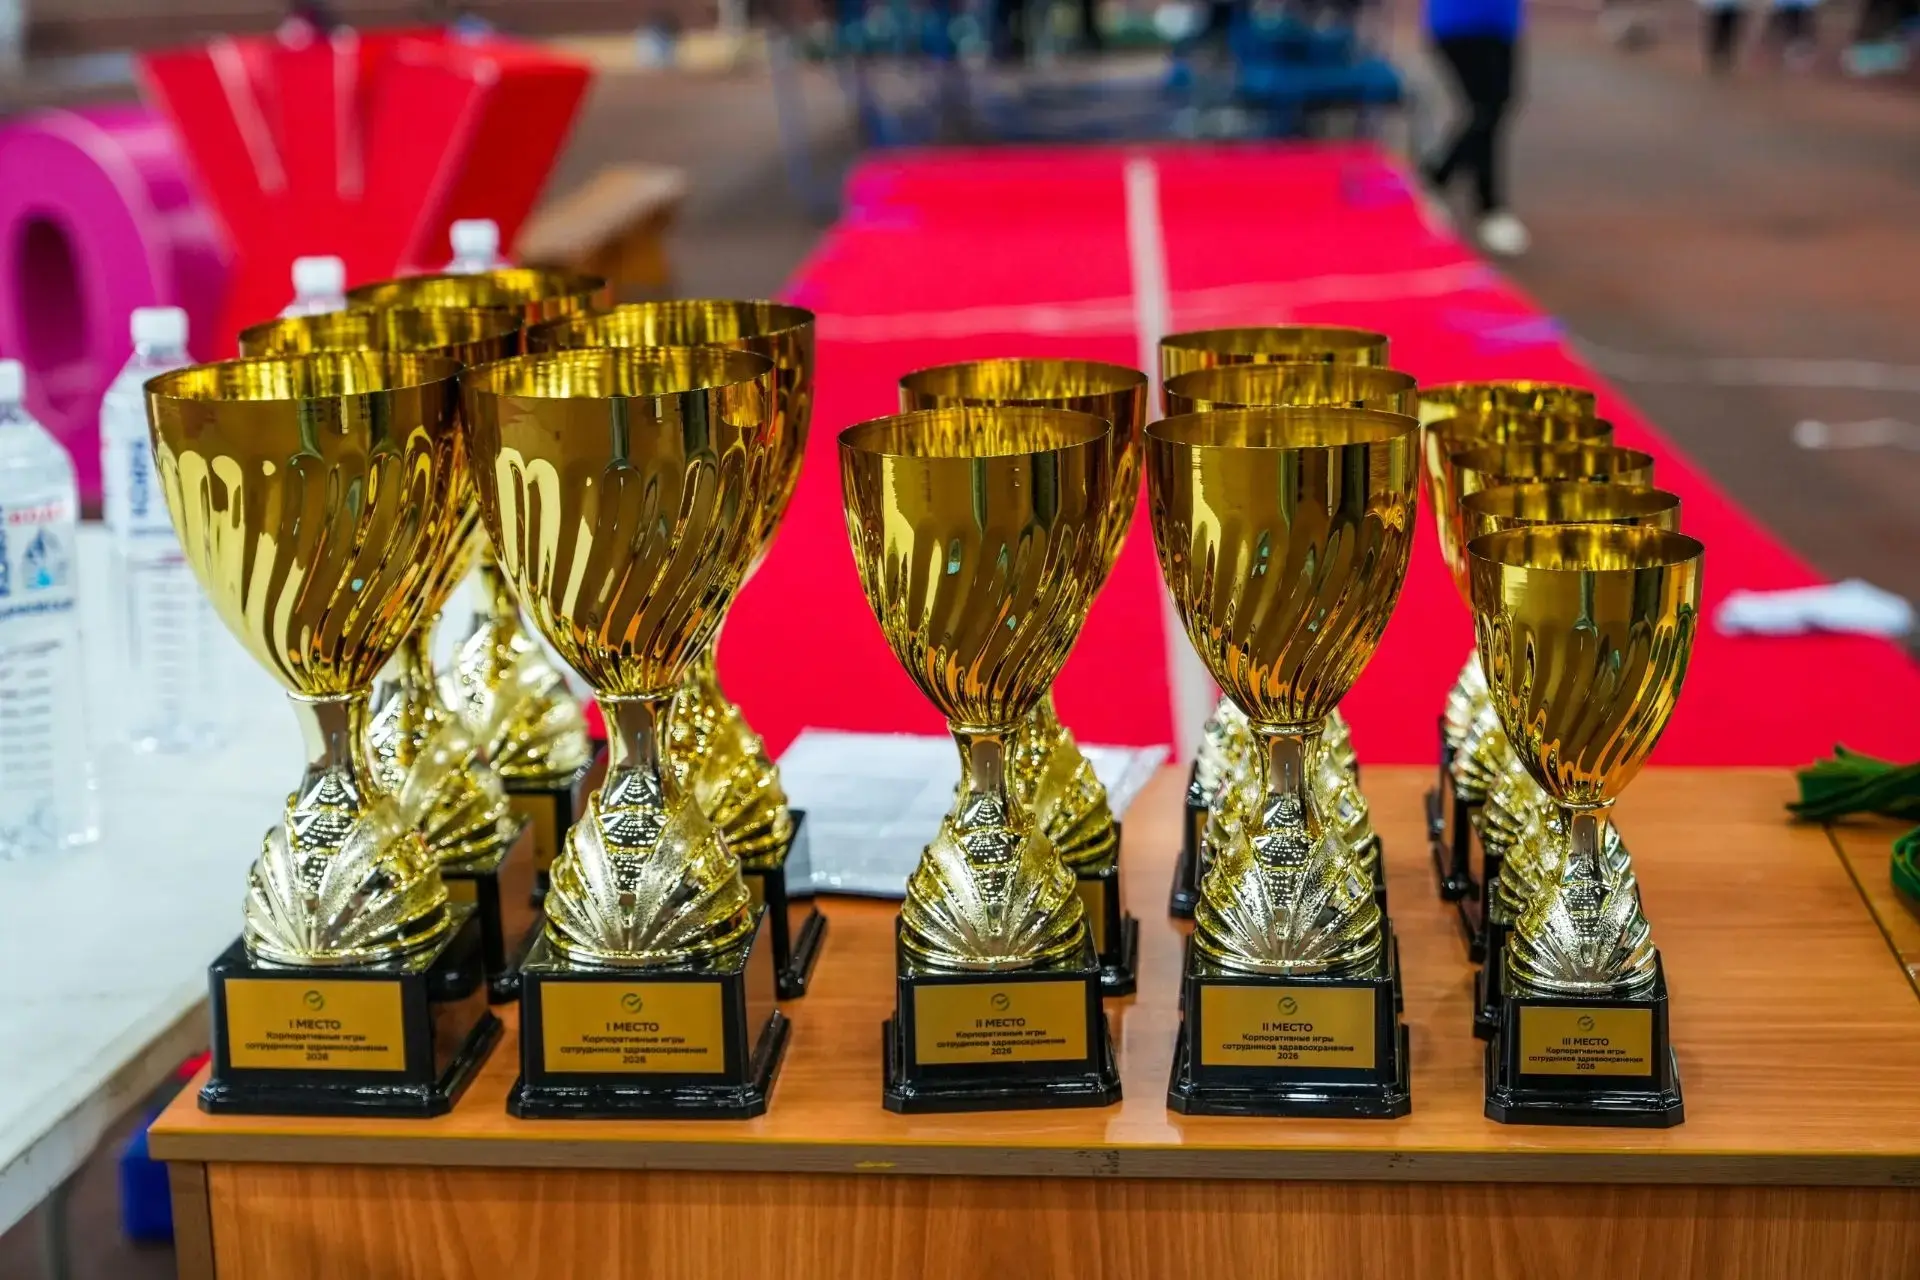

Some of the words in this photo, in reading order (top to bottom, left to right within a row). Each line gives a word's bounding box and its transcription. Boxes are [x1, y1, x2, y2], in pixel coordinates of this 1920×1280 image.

[296, 1020, 341, 1030] МЕСТО
[613, 1022, 659, 1032] МЕСТО
[985, 1018, 1025, 1027] МЕСТО
[1262, 1023, 1269, 1032] II
[1272, 1023, 1313, 1032] МЕСТО
[582, 1035, 658, 1043] Корпоративные
[956, 1030, 1022, 1039] Корпоративные
[1242, 1034, 1310, 1042] Корпоративные
[1574, 1038, 1609, 1046] МЕСТО
[1278, 1052, 1298, 1060] 2026
